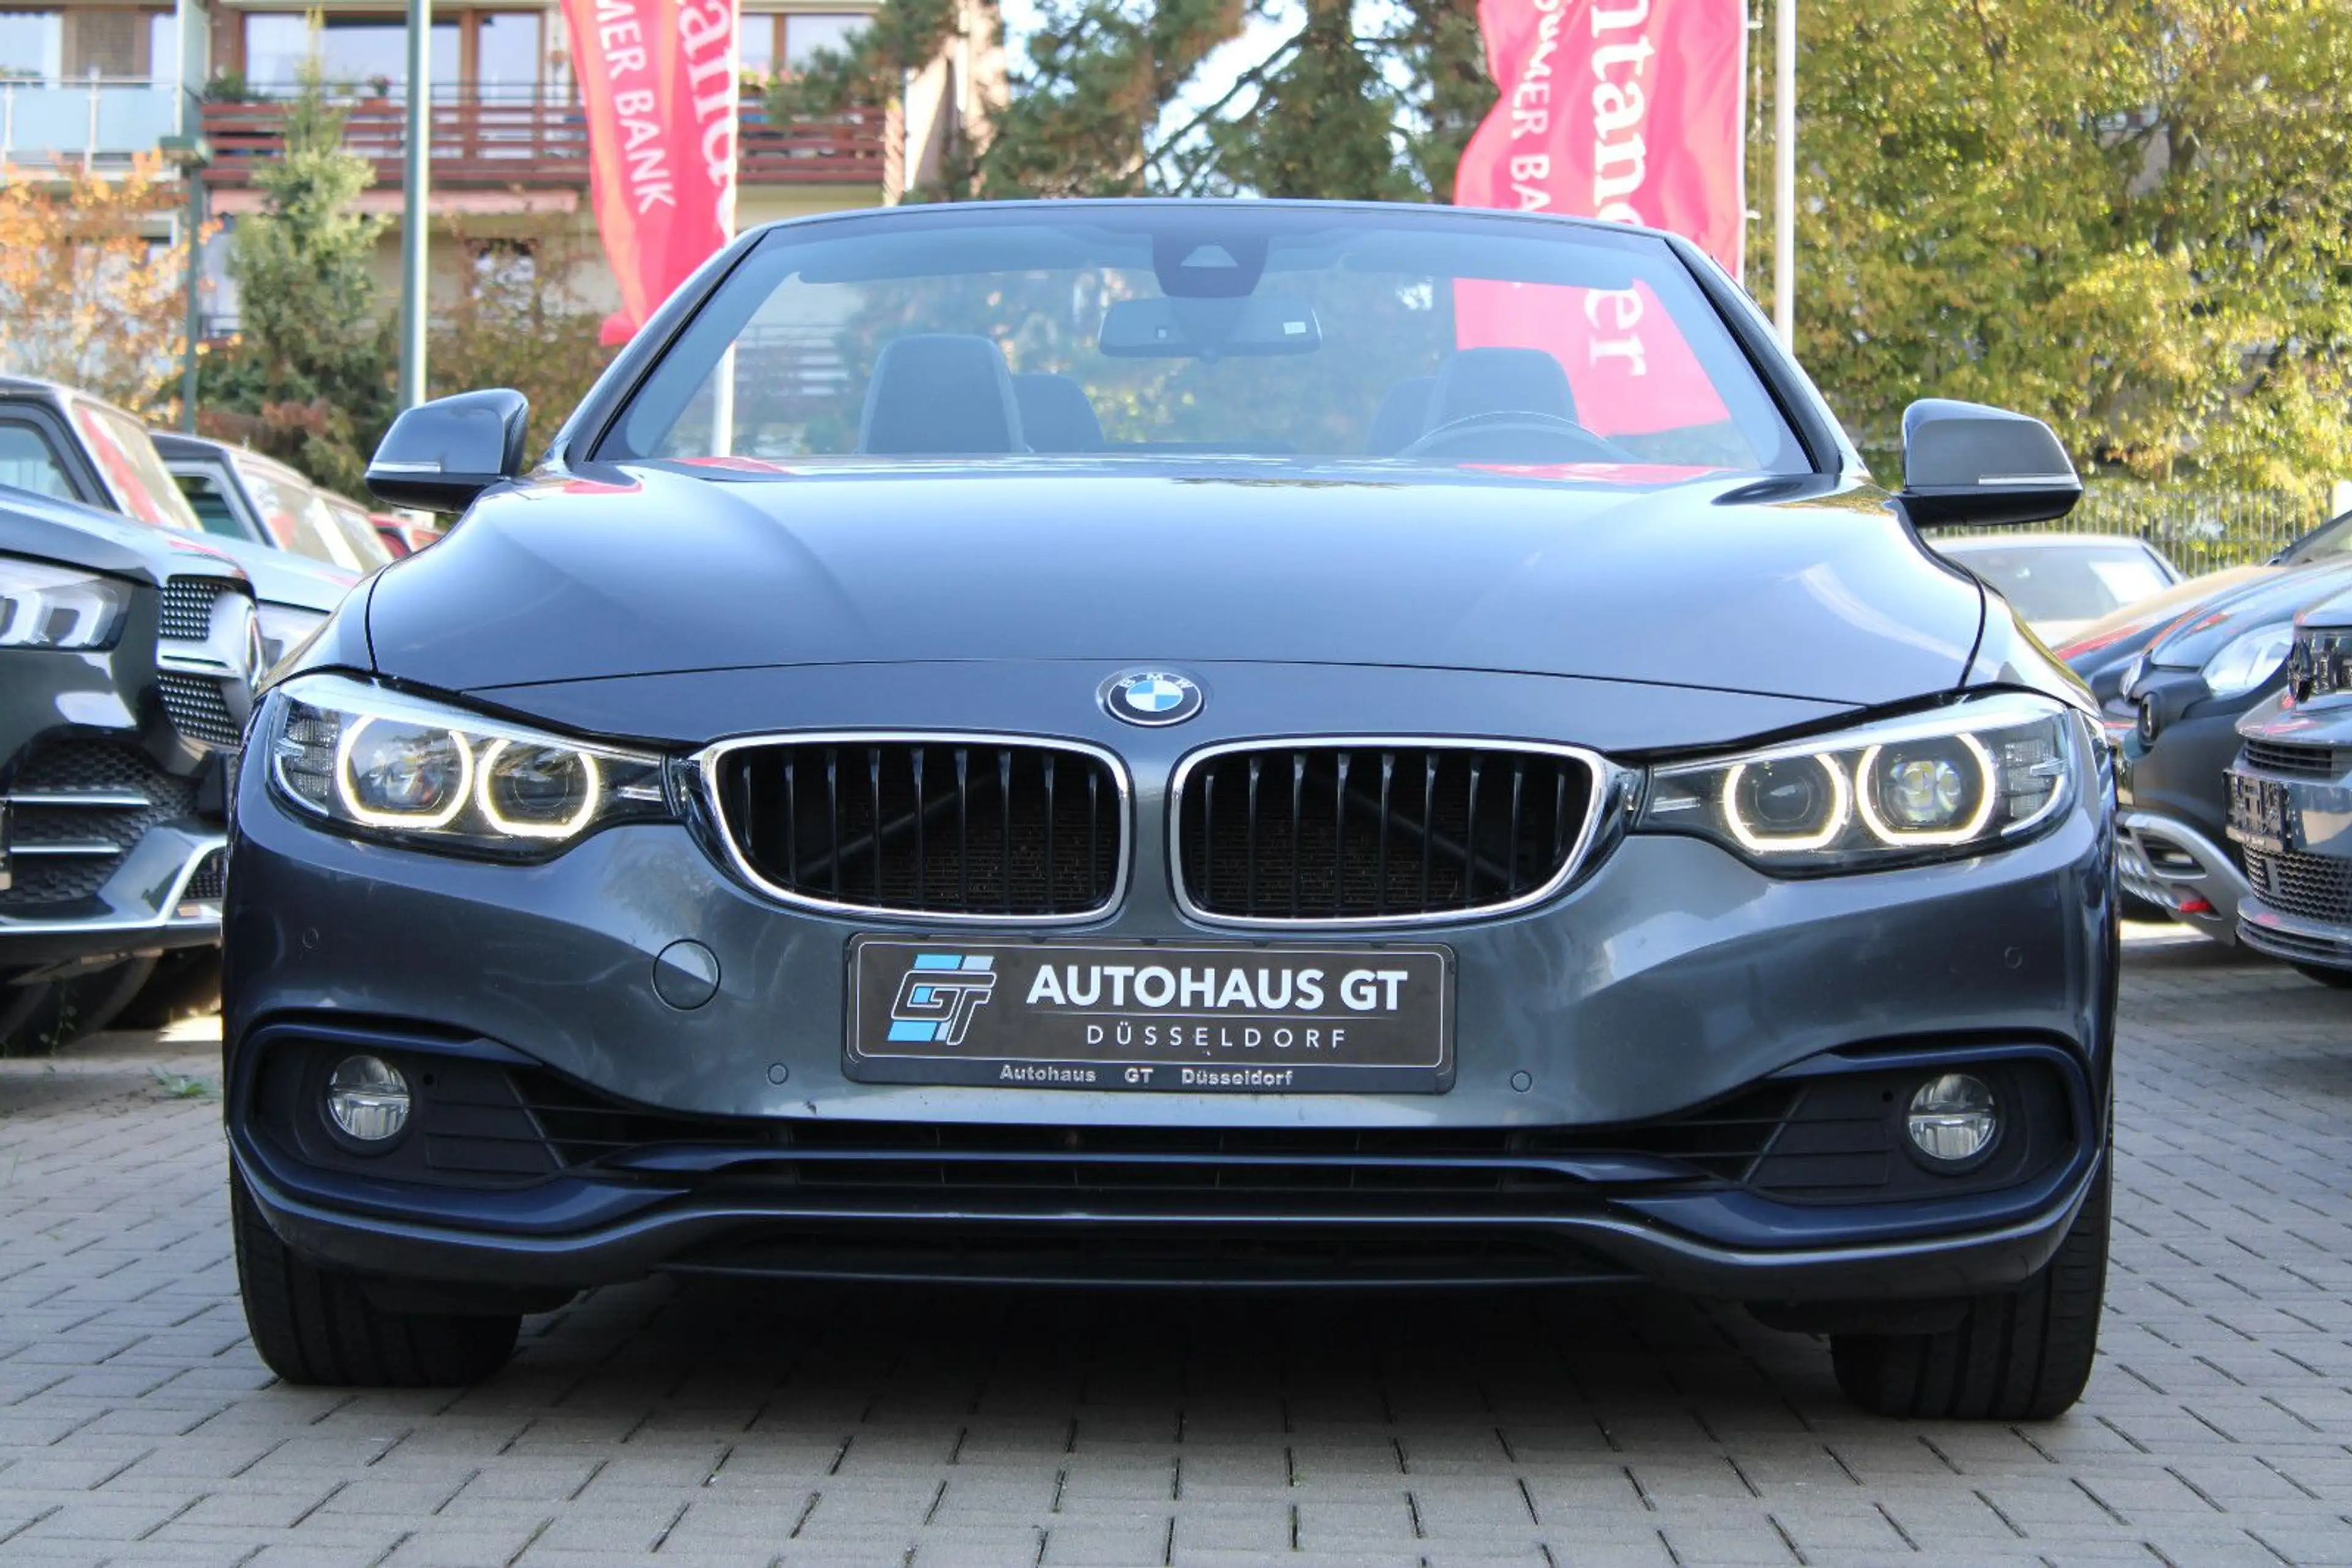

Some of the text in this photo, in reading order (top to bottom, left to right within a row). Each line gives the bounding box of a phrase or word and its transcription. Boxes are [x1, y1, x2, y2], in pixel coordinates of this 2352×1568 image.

[614, 89, 677, 215] BANK
[1026, 964, 1408, 1011] AUTOHAUS GT
[1087, 1021, 1345, 1049] DÜSSELDORF
[999, 1064, 1294, 1087] Autohaus GT Düsseldorf
